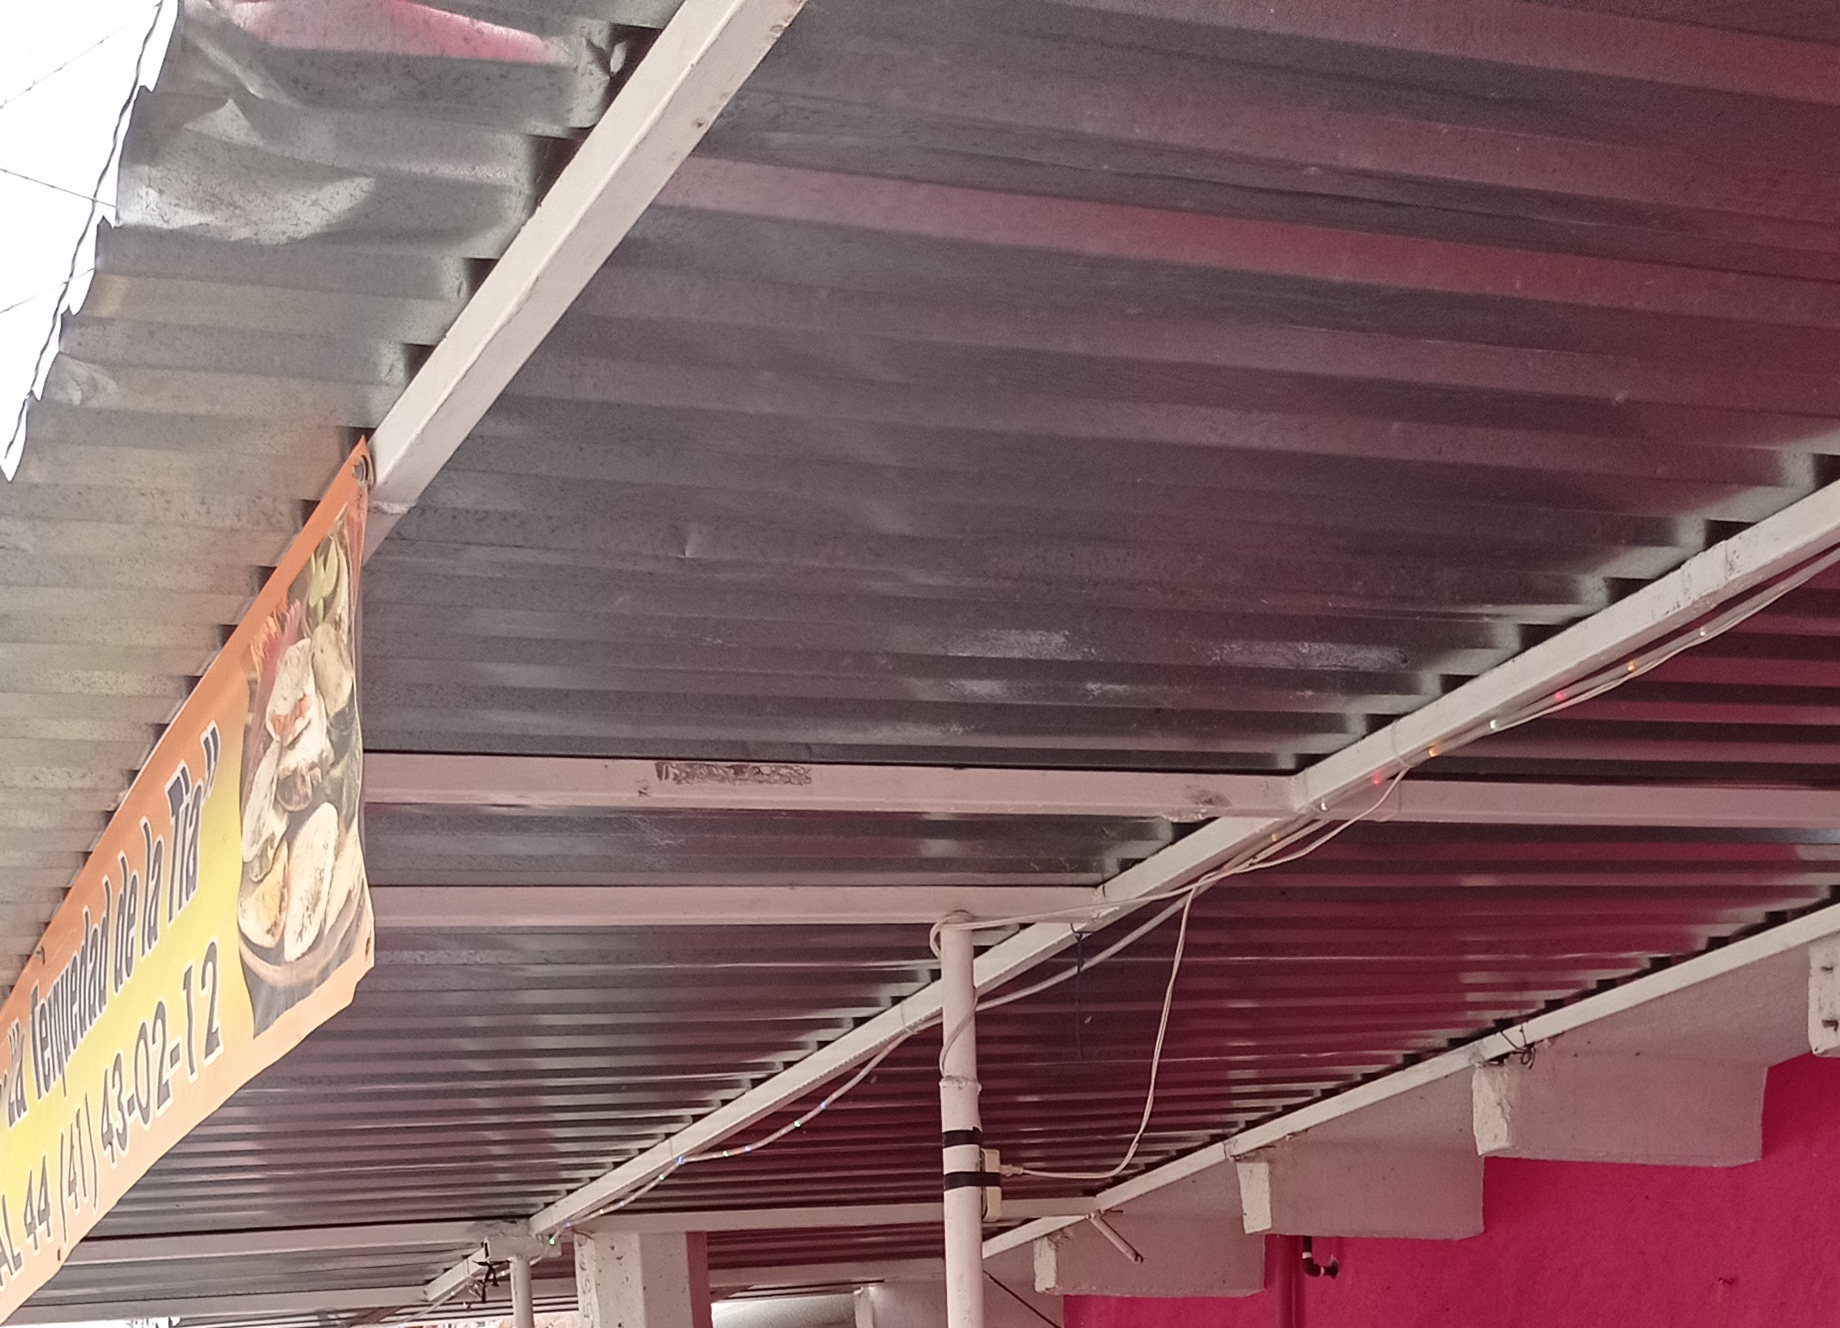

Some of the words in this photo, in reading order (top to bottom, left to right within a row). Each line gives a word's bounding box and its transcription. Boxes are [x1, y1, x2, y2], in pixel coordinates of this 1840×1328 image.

[24, 1154, 51, 1251] 44
[60, 1091, 98, 1243] (41)
[101, 940, 221, 1166] 43-02-12
[30, 879, 111, 1100] Terquedad
[114, 854, 138, 994] de
[140, 820, 164, 959] la
